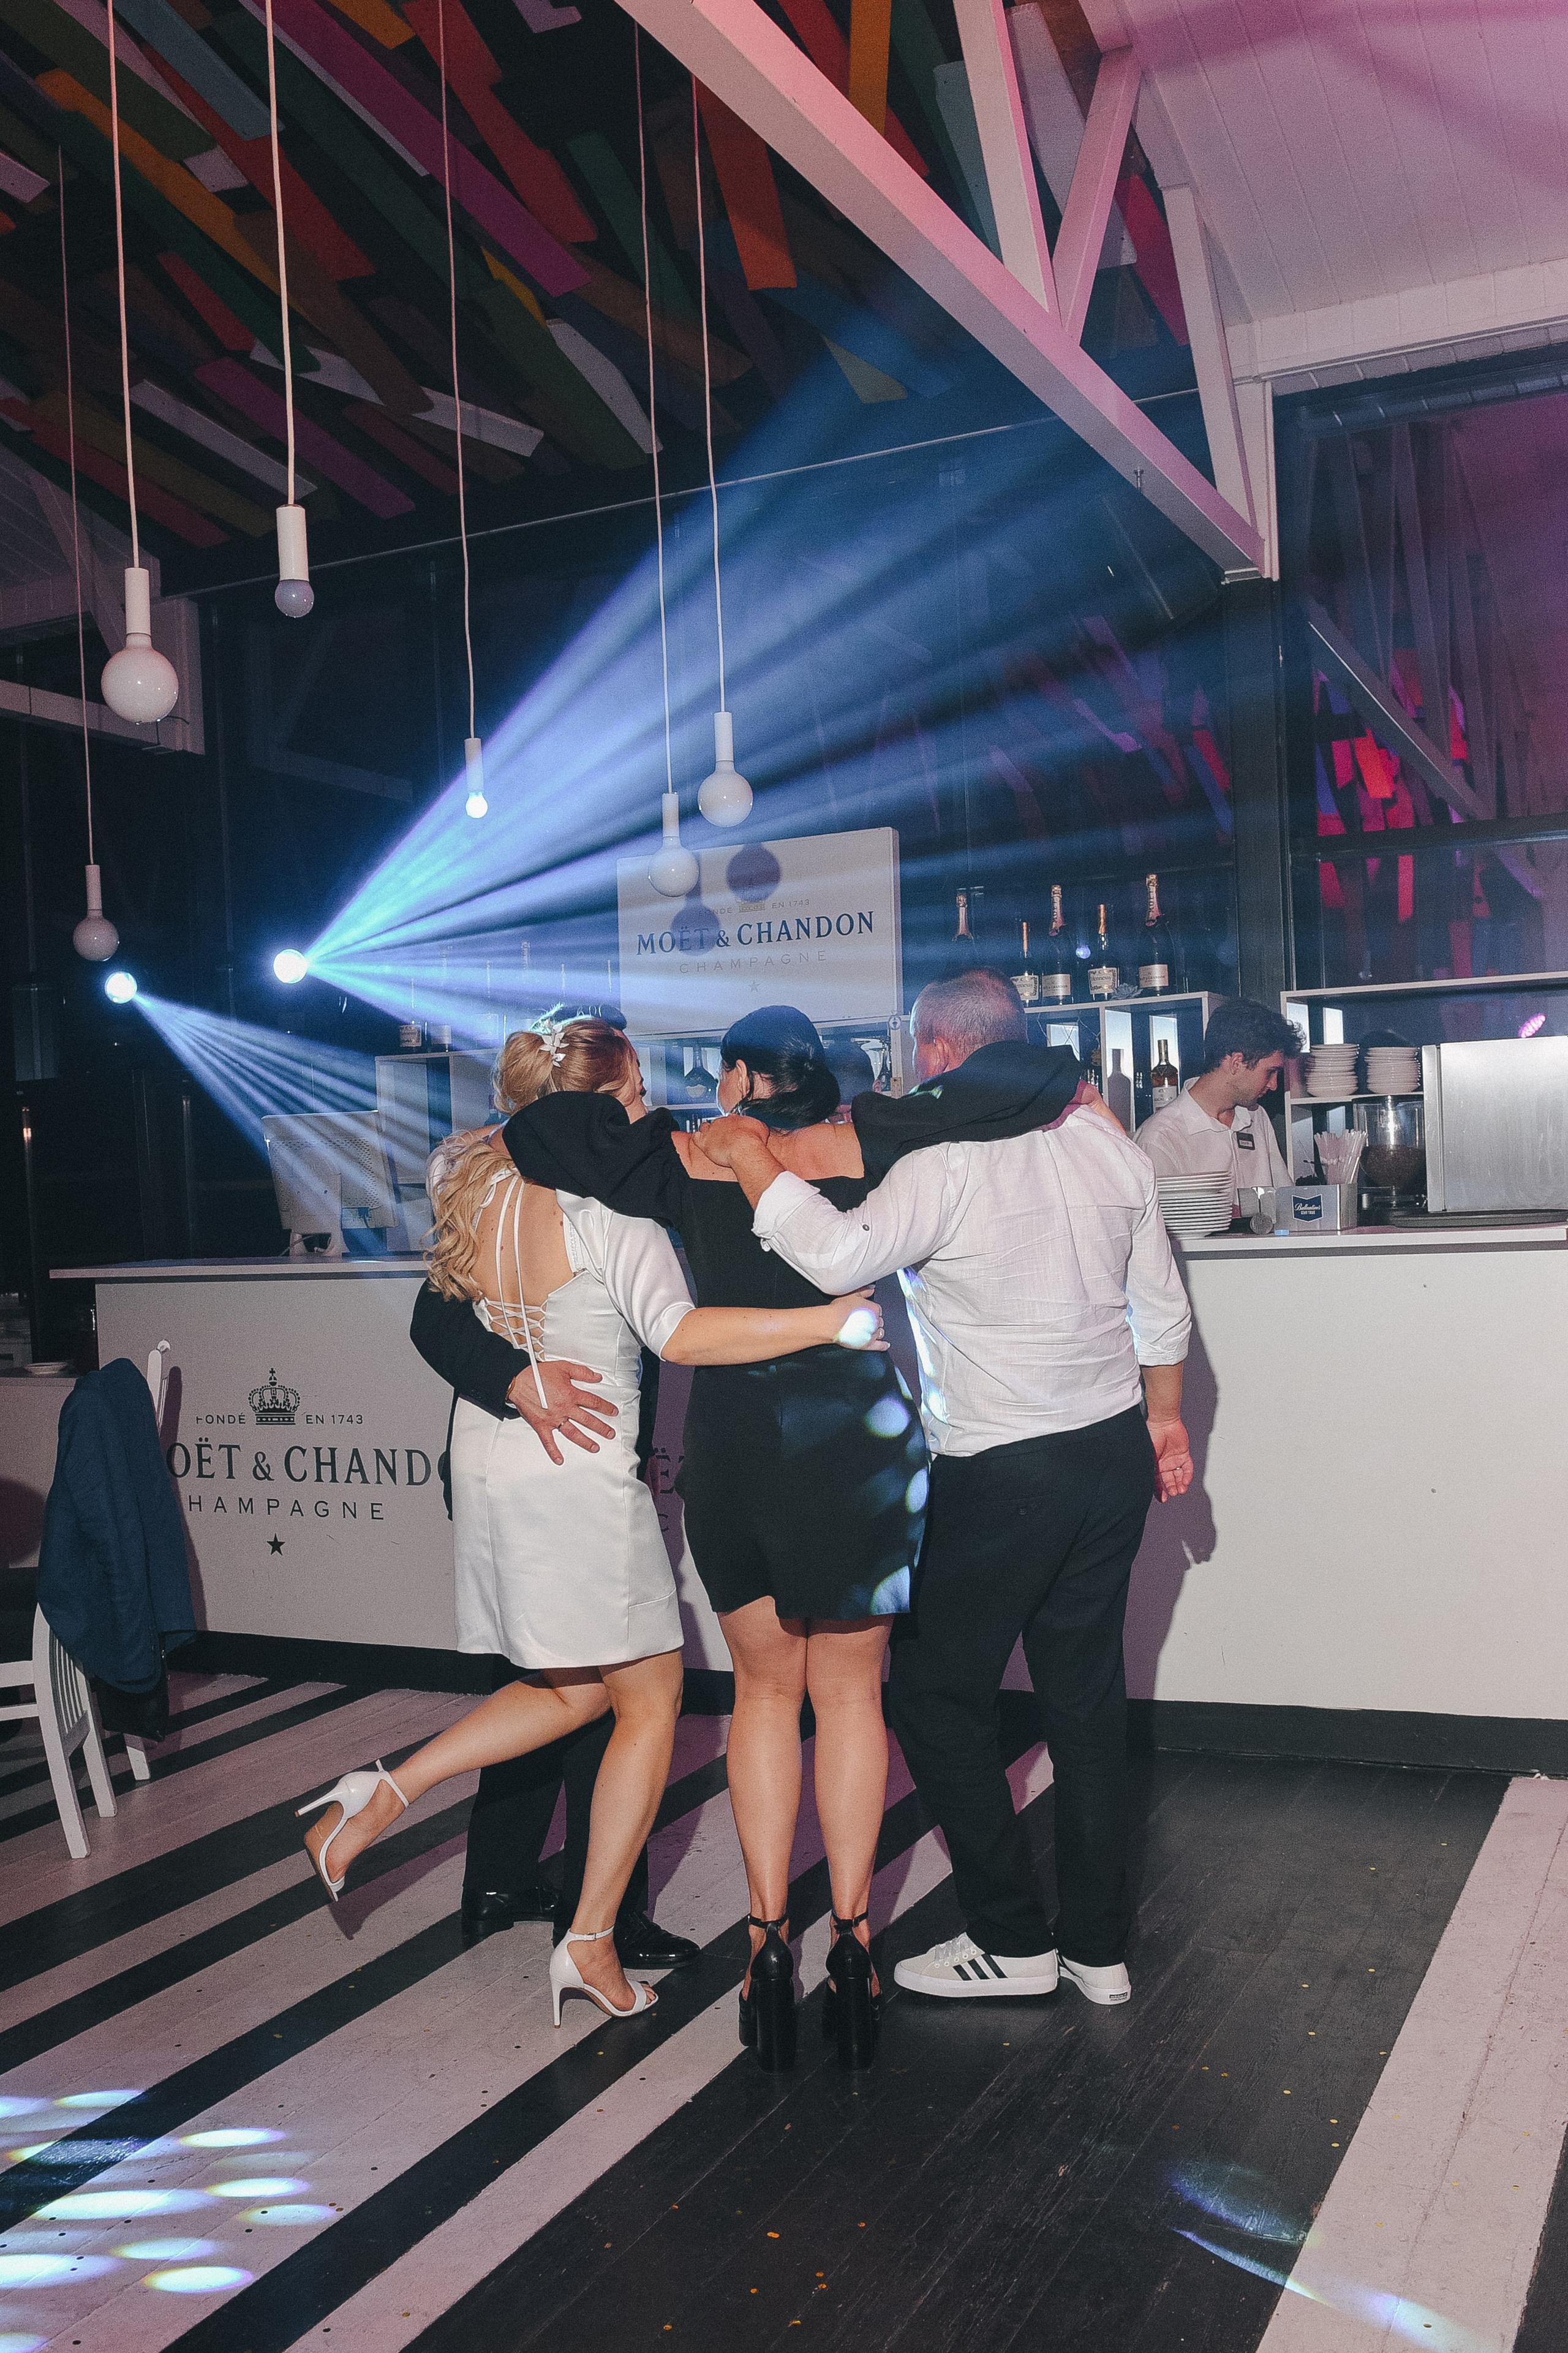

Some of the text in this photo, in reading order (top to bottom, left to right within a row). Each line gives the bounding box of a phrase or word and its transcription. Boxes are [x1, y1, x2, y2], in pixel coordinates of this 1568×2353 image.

[789, 899, 810, 907] 1743
[636, 910, 874, 956] MOËT & CHANDON
[679, 950, 827, 974] CHAMPAGNE
[306, 1414, 325, 1424] EN
[331, 1414, 364, 1424] 1743
[166, 1437, 241, 1479] OËT
[252, 1451, 274, 1481] &
[189, 1495, 385, 1520] HAMPAGNE
